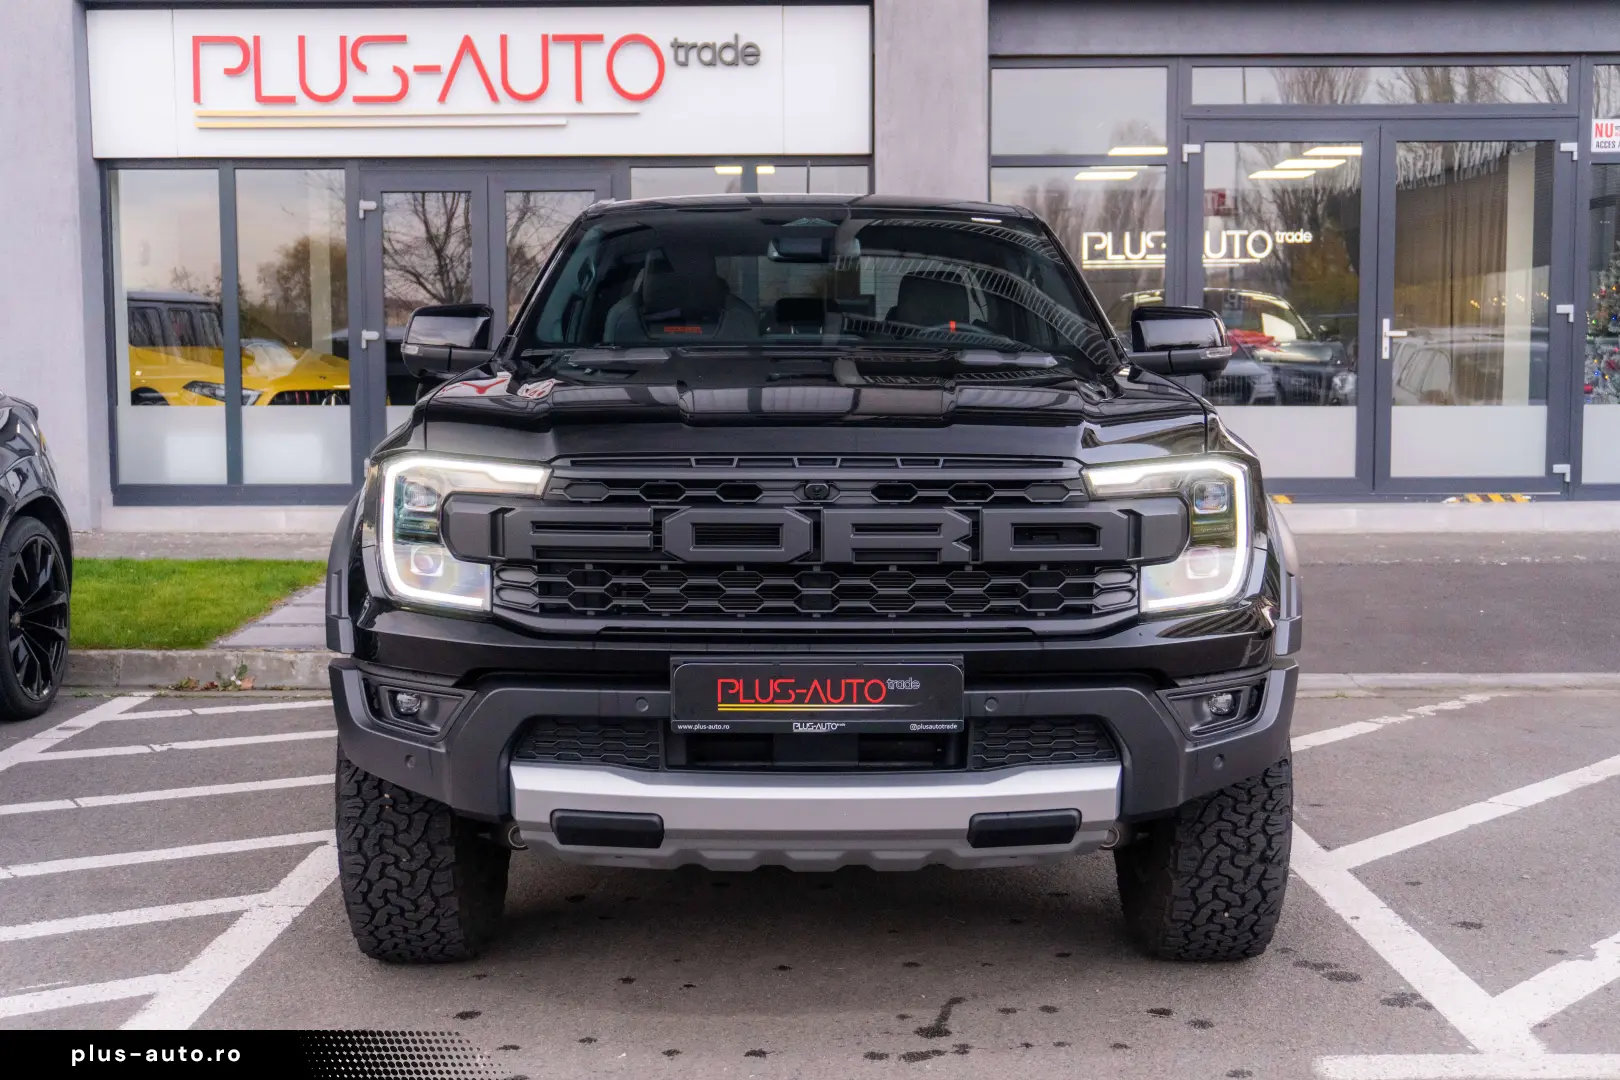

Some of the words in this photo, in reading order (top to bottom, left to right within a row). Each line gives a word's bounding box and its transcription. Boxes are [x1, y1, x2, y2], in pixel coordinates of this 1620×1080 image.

[192, 33, 666, 105] PLUS-AUTO
[669, 33, 761, 67] trade
[1595, 122, 1614, 138] NU
[1595, 140, 1616, 149] ACCES
[1275, 229, 1313, 244] trade
[503, 504, 1131, 563] FORD
[717, 678, 887, 703] PLUS-AUTO
[886, 677, 921, 690] trade
[677, 722, 730, 731] www.plus-auto.ro
